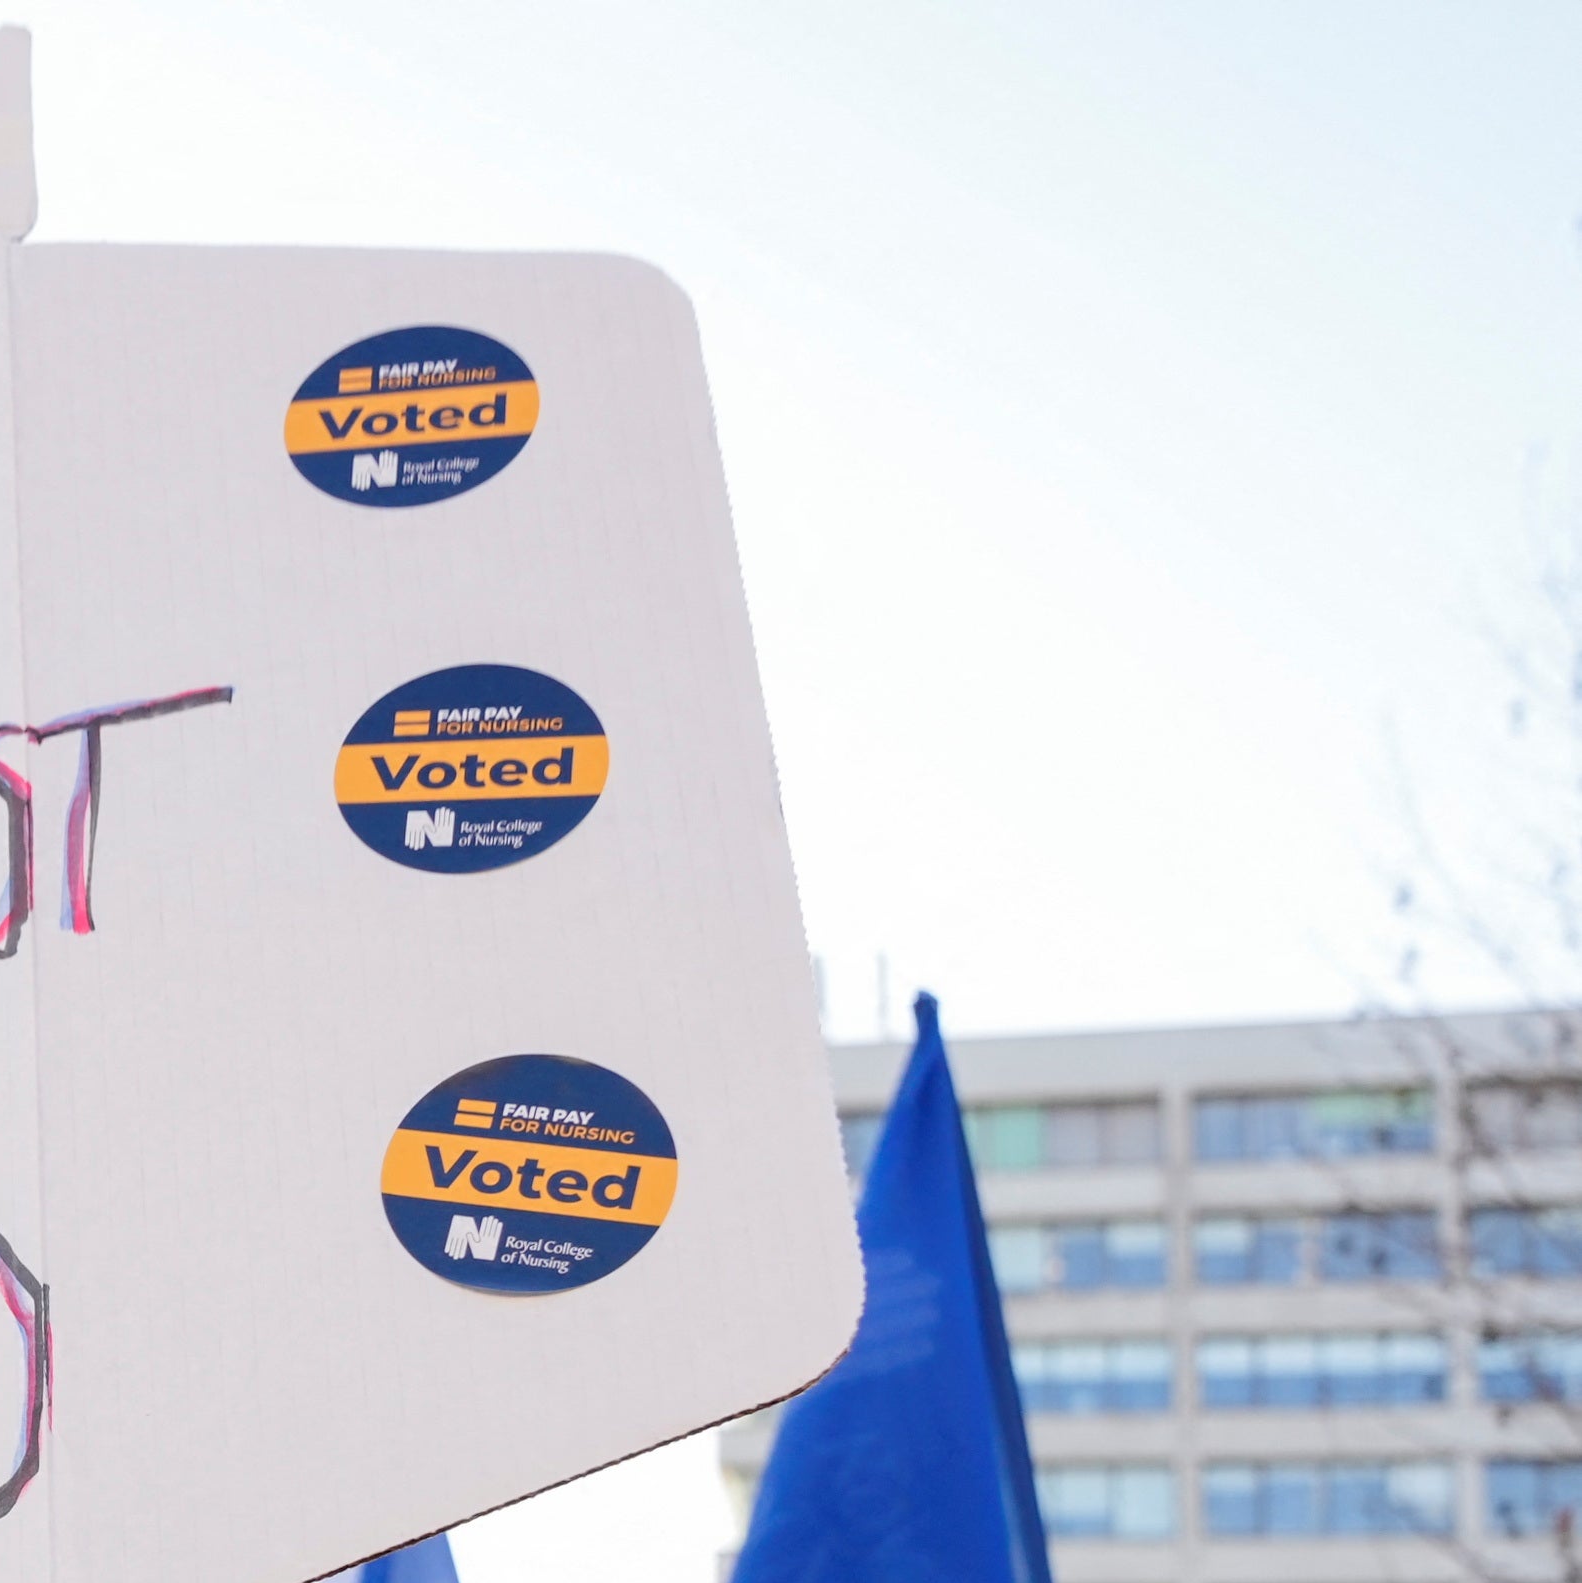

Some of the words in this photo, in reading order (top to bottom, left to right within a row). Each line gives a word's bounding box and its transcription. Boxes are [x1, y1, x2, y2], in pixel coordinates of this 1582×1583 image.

[378, 363, 419, 378] FAIR
[422, 358, 458, 375] PAY
[378, 374, 413, 390] FOR
[417, 366, 496, 387] NURSING
[319, 392, 507, 440] Voted
[437, 708, 481, 723] FAIR
[484, 706, 522, 721] PAY
[437, 721, 473, 735] FOR
[478, 717, 563, 733] NURSING
[371, 746, 574, 791] Voted
[460, 820, 494, 835] Royal
[497, 819, 543, 834] College
[459, 834, 473, 847] of
[475, 832, 523, 849] Nursing
[502, 1103, 550, 1121] FAIR
[552, 1108, 595, 1125] PAY
[499, 1118, 538, 1134] FOR
[543, 1122, 635, 1145] NURSING
[425, 1144, 641, 1210] Voted
[505, 1235, 542, 1254] Royal
[543, 1240, 594, 1260] College
[501, 1251, 516, 1264] of
[518, 1253, 570, 1274] Nursing
